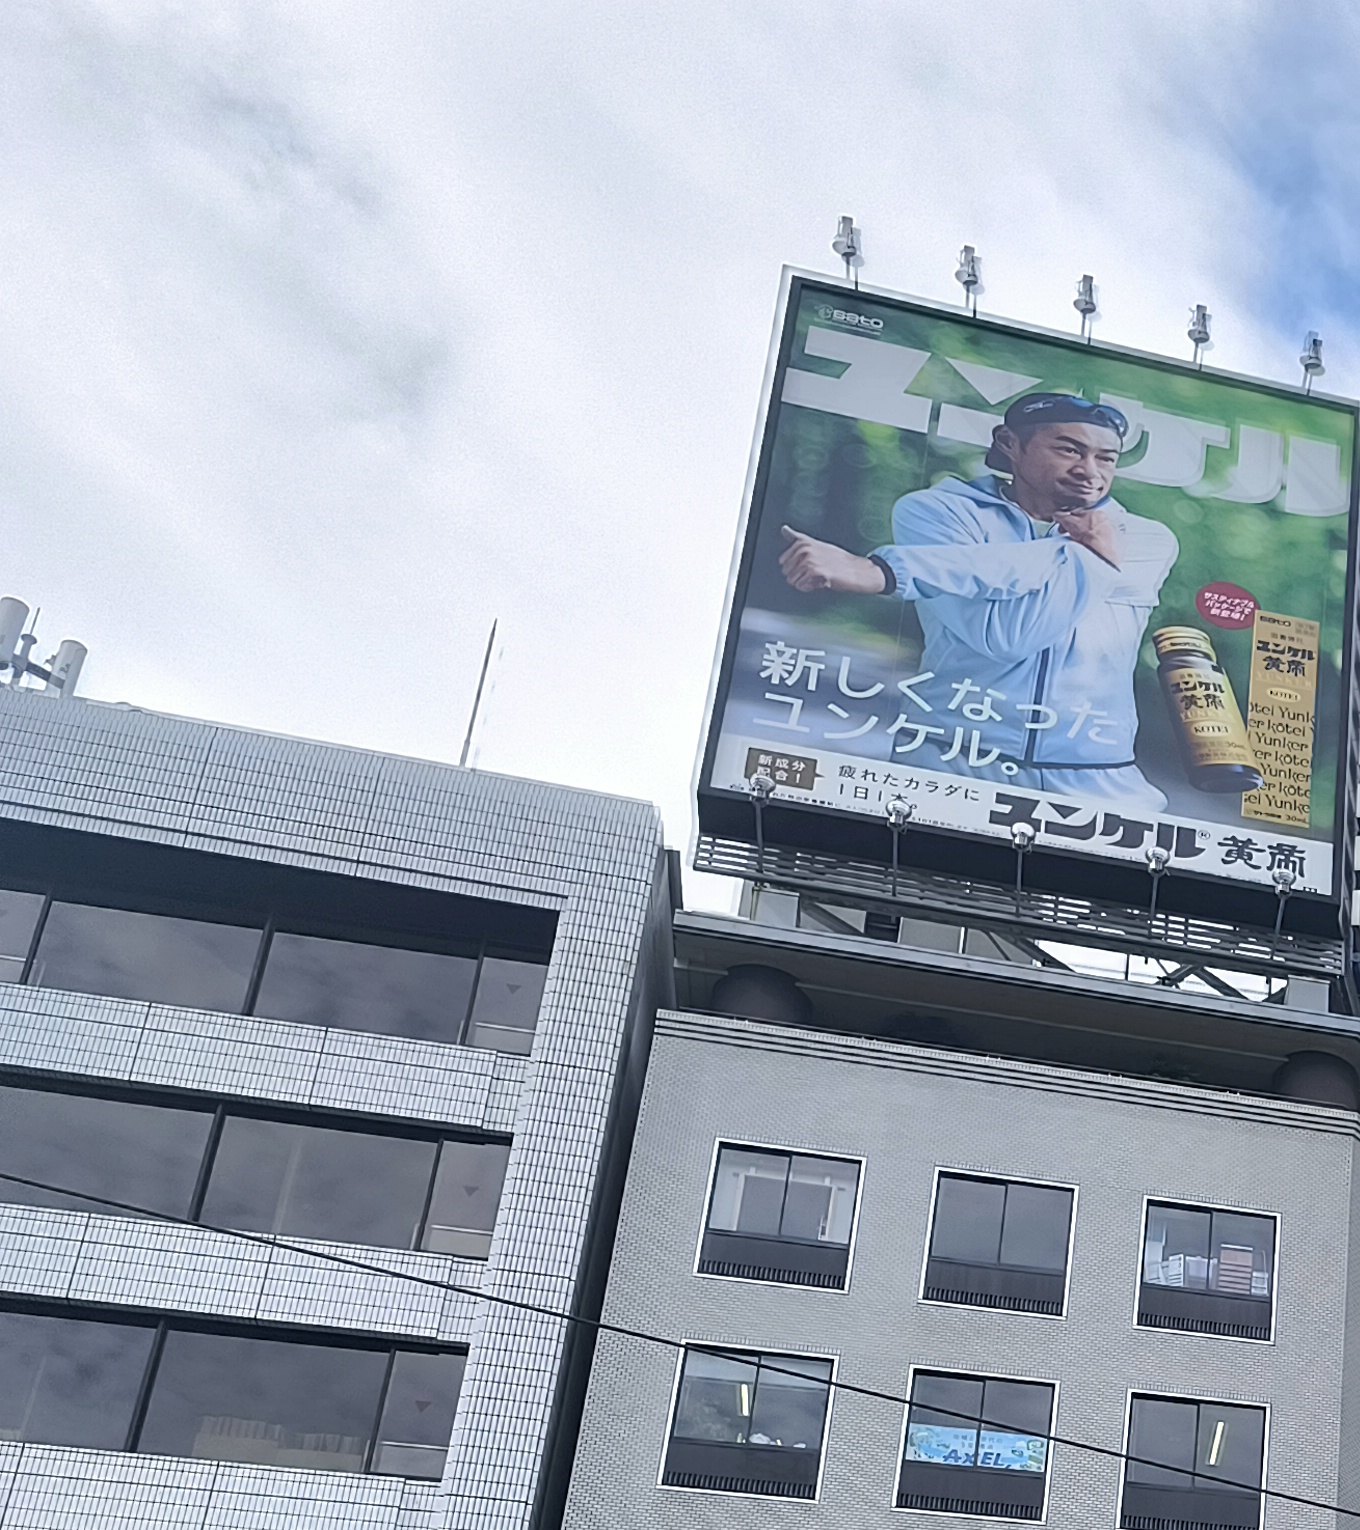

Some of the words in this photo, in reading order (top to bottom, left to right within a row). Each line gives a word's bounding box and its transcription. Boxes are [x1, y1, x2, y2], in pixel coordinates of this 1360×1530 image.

[1256, 640, 1316, 660] ユンケル
[758, 639, 1118, 746] 新しくなった
[757, 754, 807, 772] 新成分
[838, 764, 980, 802] 疲れたカラダに
[1217, 834, 1307, 879] 黄帝
